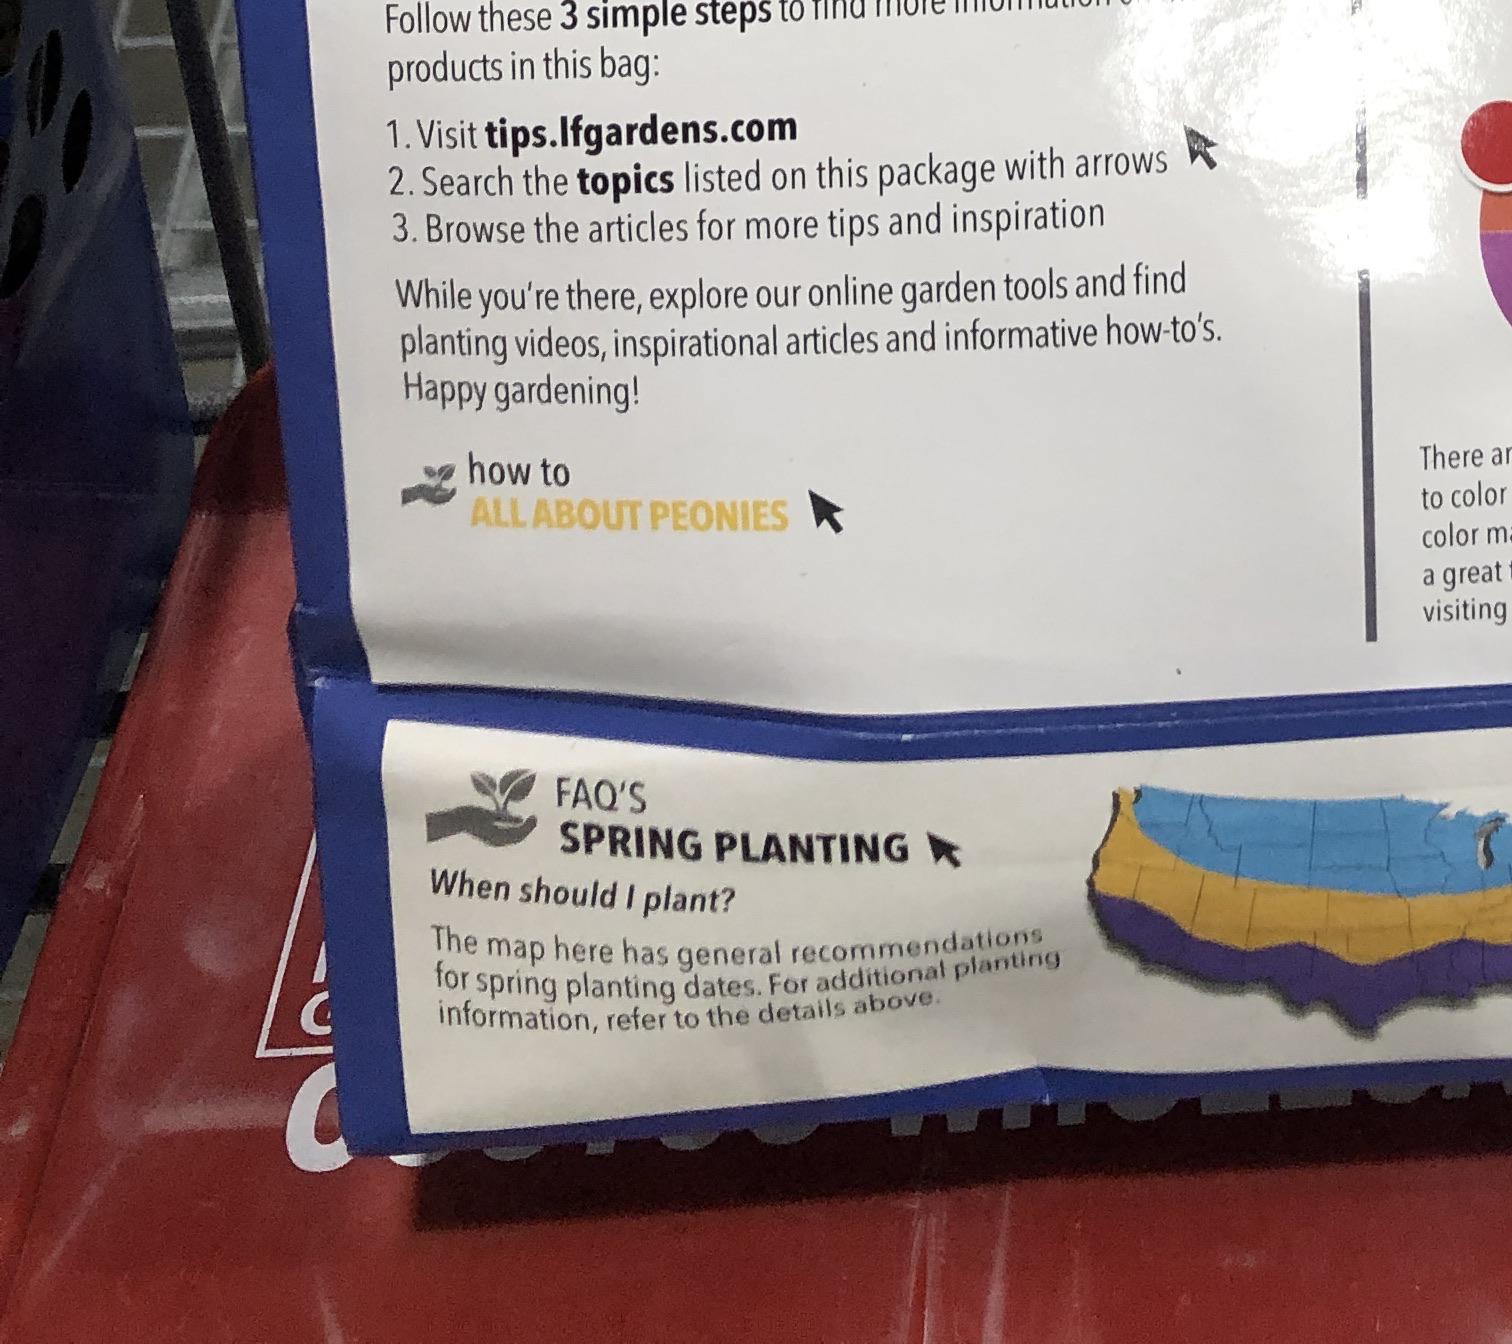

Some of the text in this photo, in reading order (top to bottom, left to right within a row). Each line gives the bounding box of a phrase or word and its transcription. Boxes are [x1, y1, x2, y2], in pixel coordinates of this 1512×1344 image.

[386, 112, 797, 158] 1. Visit tips.lfgardens.com
[468, 450, 570, 487] how to
[470, 496, 789, 532] ALL ABOUT PEONIES
[1423, 598, 1507, 626] visiting
[556, 776, 647, 814] FAQ'S
[560, 821, 909, 864] SPRING PLANTING
